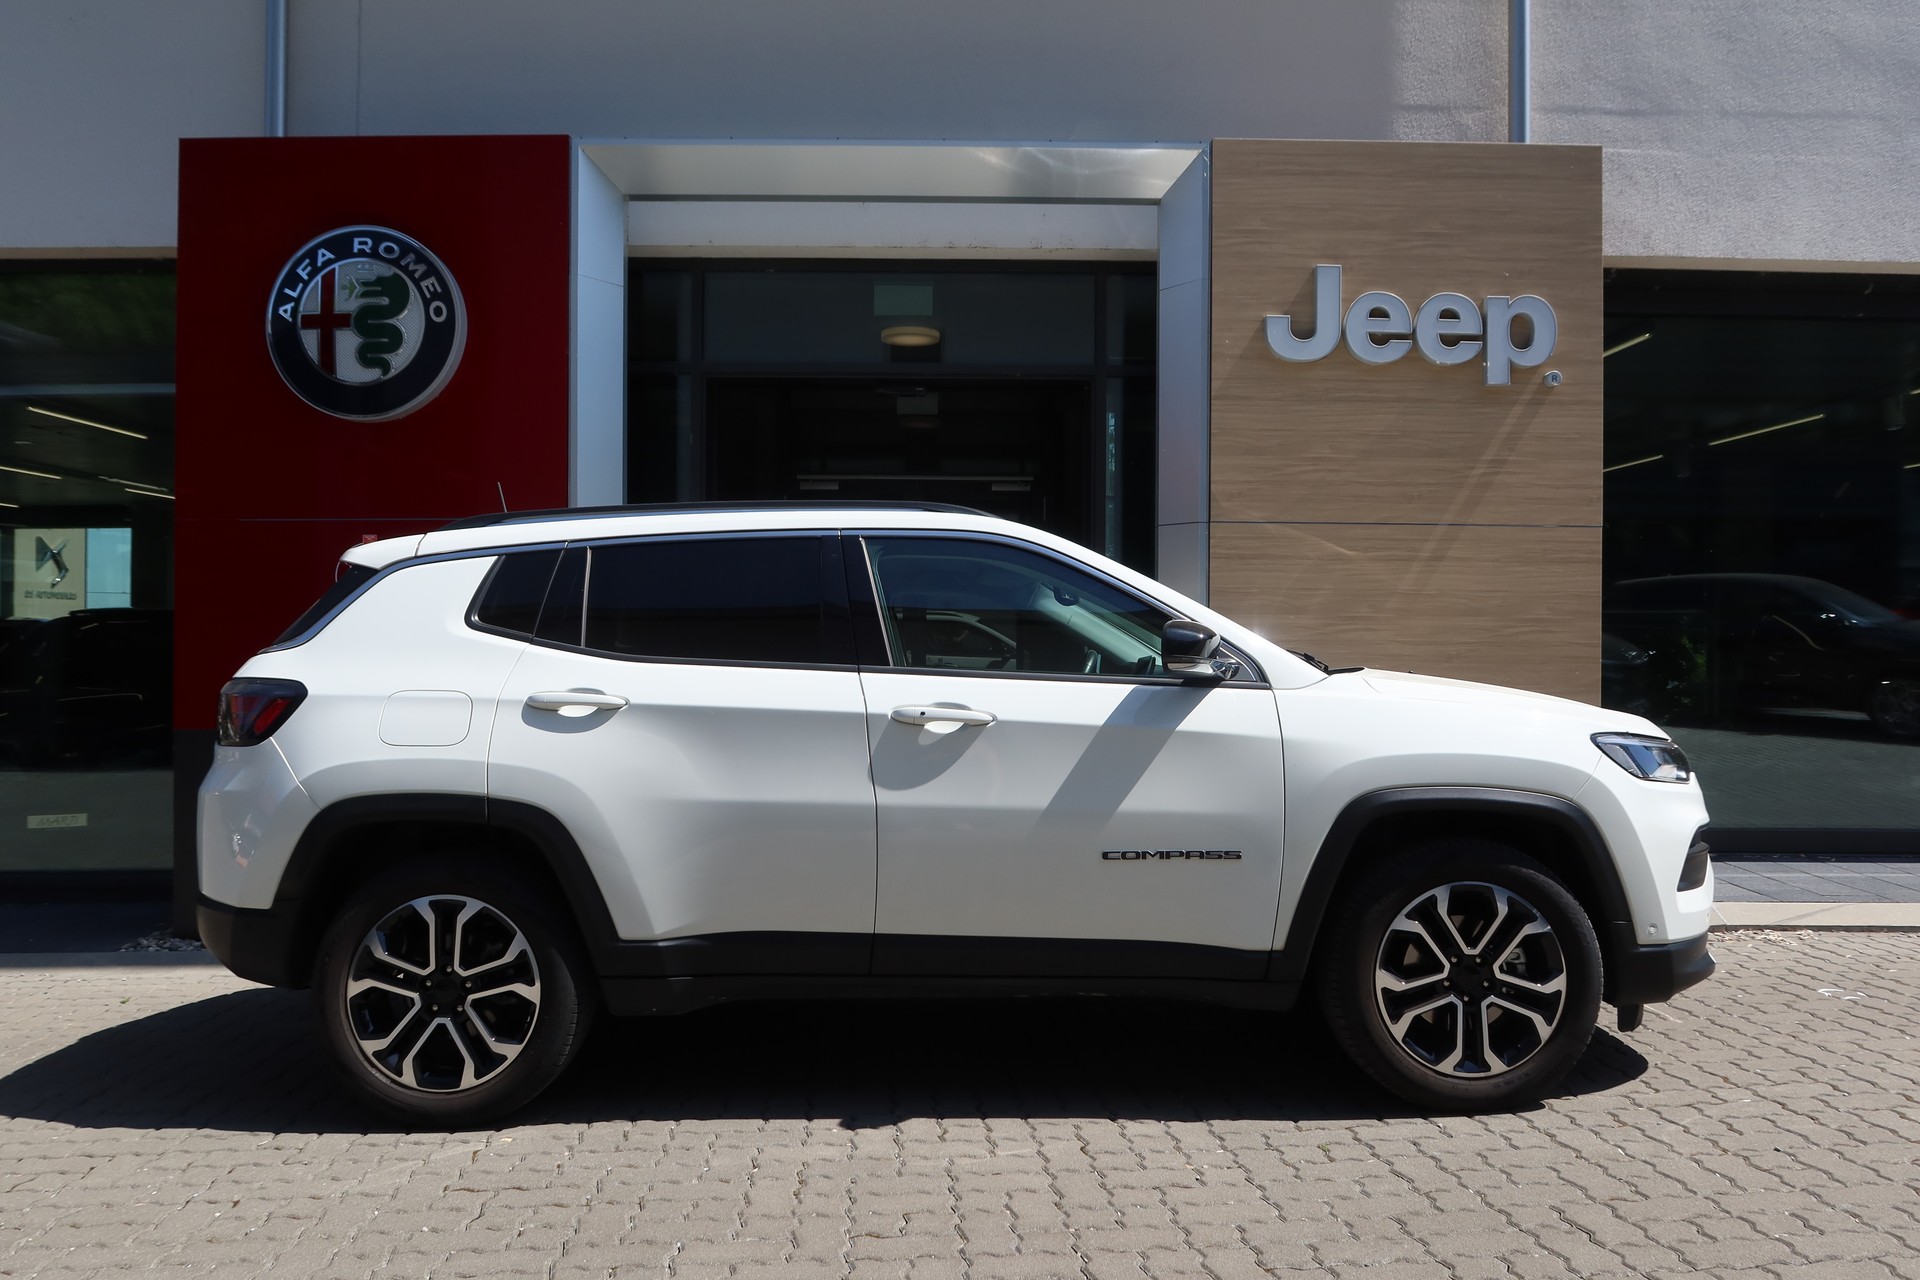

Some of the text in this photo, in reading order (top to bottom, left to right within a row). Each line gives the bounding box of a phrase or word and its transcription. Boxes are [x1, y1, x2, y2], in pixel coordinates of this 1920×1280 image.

[279, 237, 448, 323] ALFA ROMEO
[1264, 264, 1558, 386] Jeep
[1102, 850, 1242, 860] COMPASS
